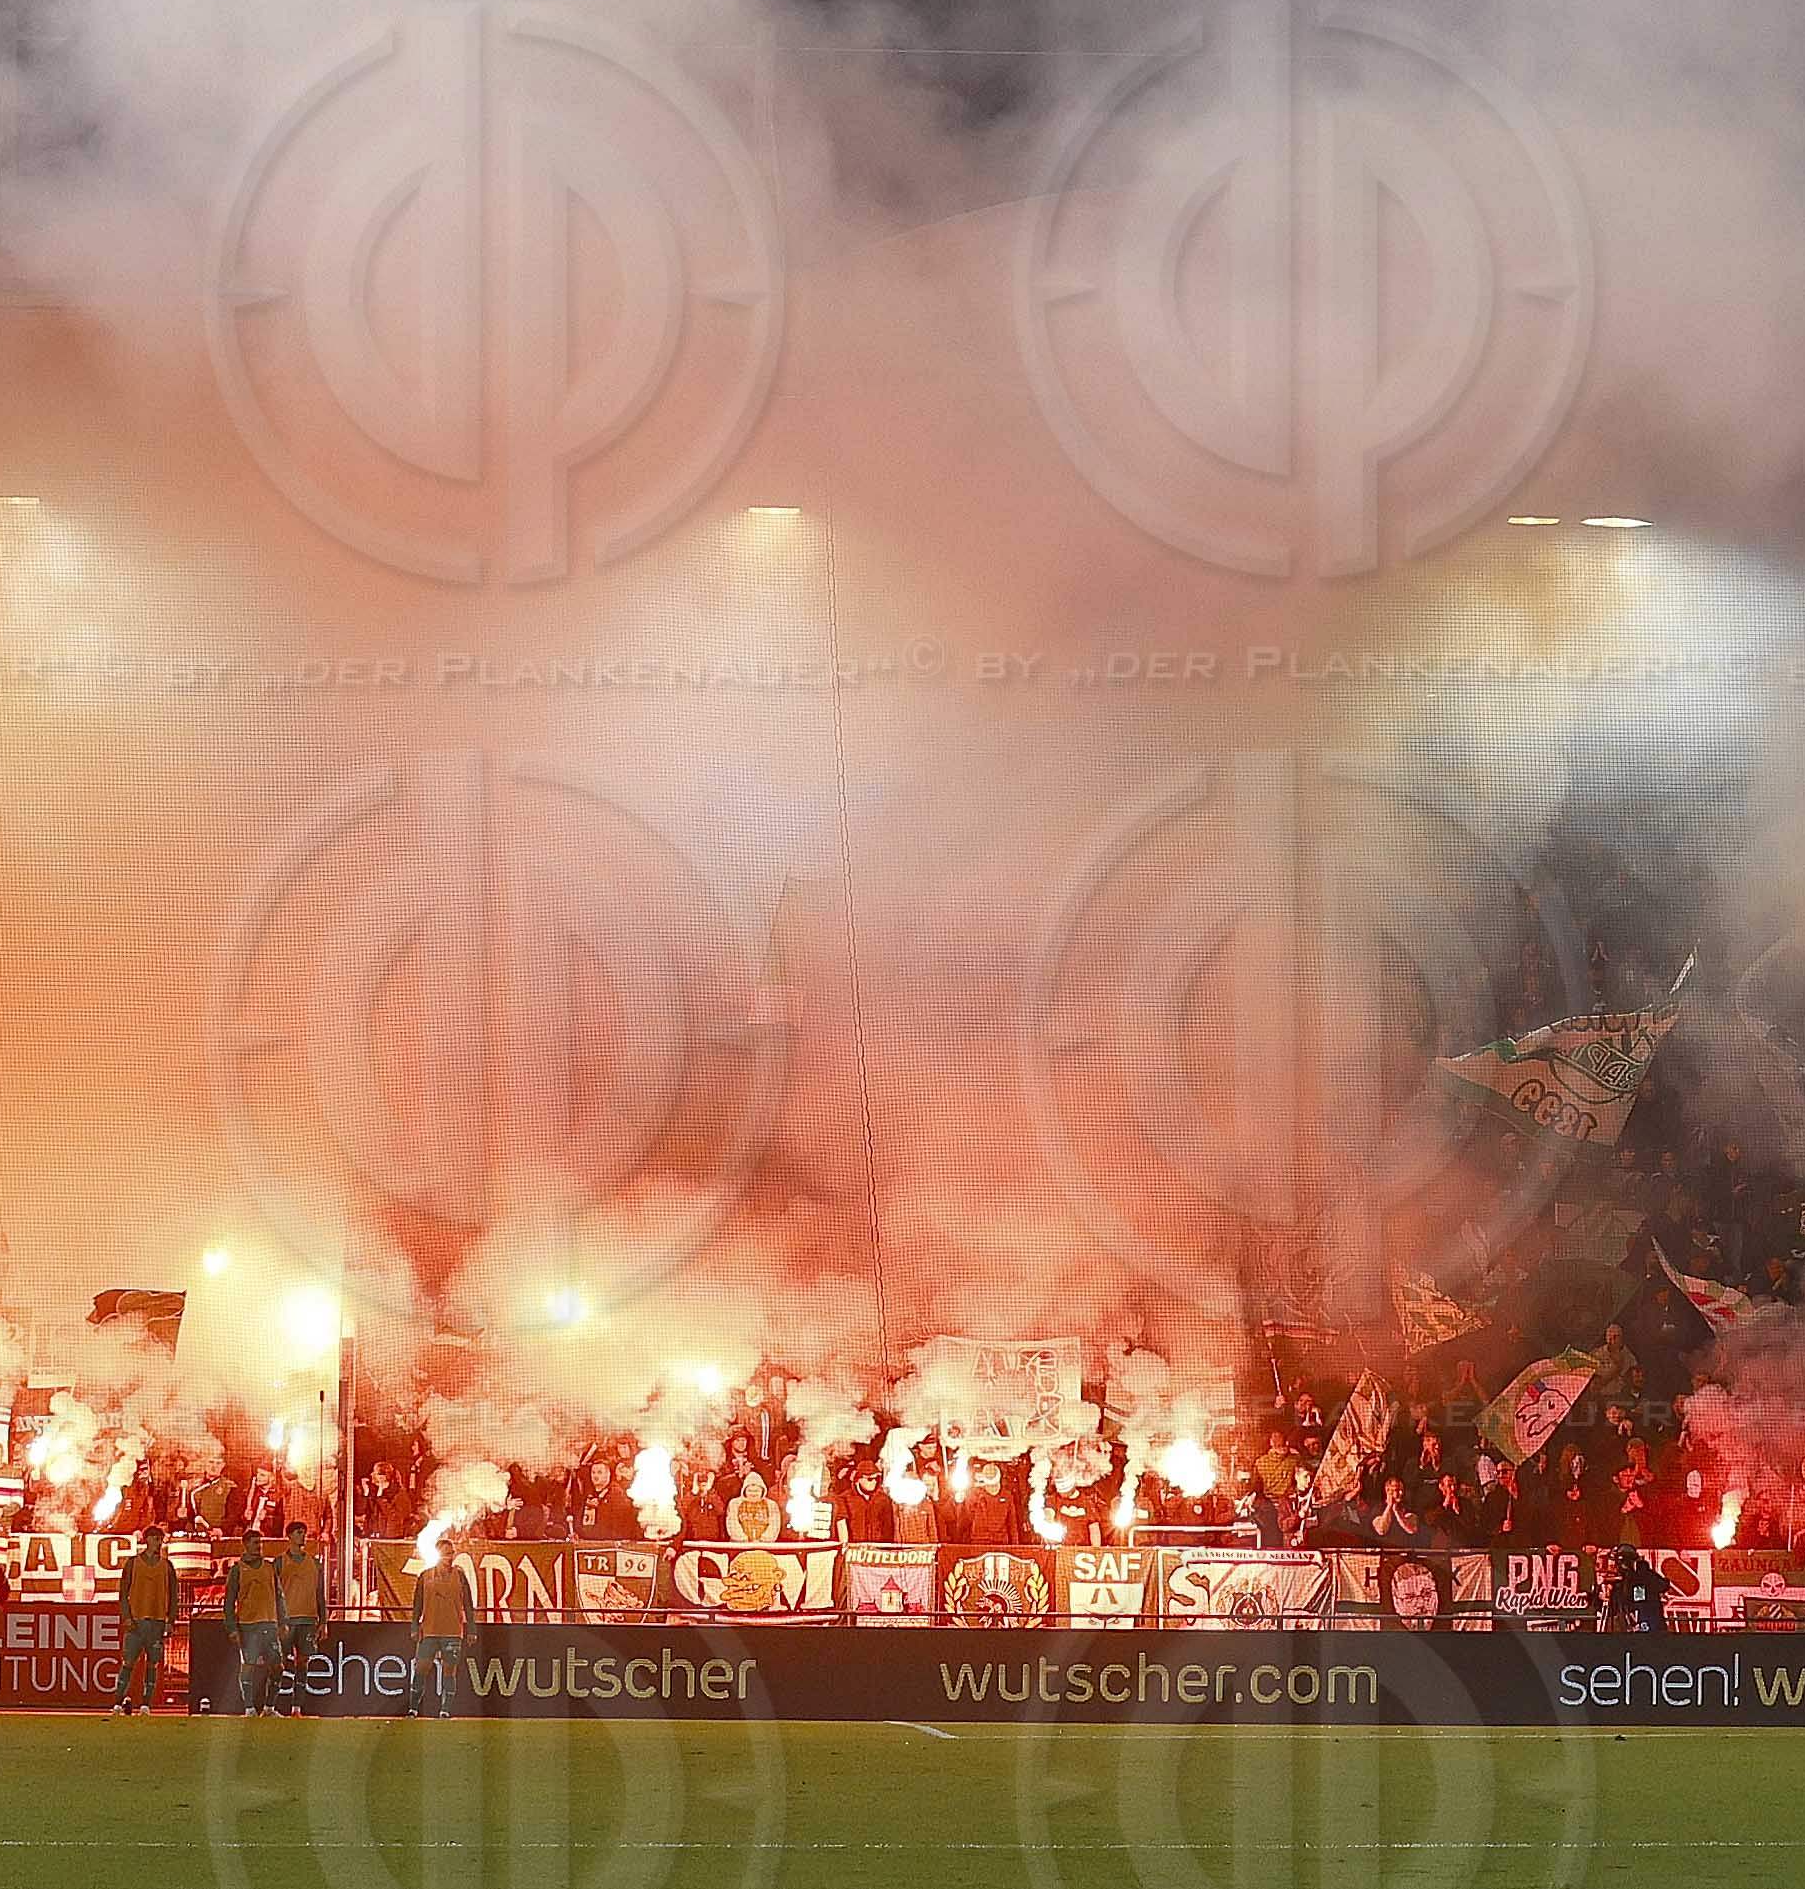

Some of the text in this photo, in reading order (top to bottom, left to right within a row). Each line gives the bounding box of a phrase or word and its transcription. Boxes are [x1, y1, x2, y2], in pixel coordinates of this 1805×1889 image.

[846, 1547, 937, 1564] HÜTTELDORF
[1074, 1552, 1142, 1581] SAF
[1506, 1553, 1581, 1592] PNG
[1496, 1586, 1590, 1613] Rapid Wien
[467, 1647, 757, 1700] wutscher
[938, 1652, 1379, 1704] wutscher.com
[1559, 1652, 1740, 1707] sehen!
